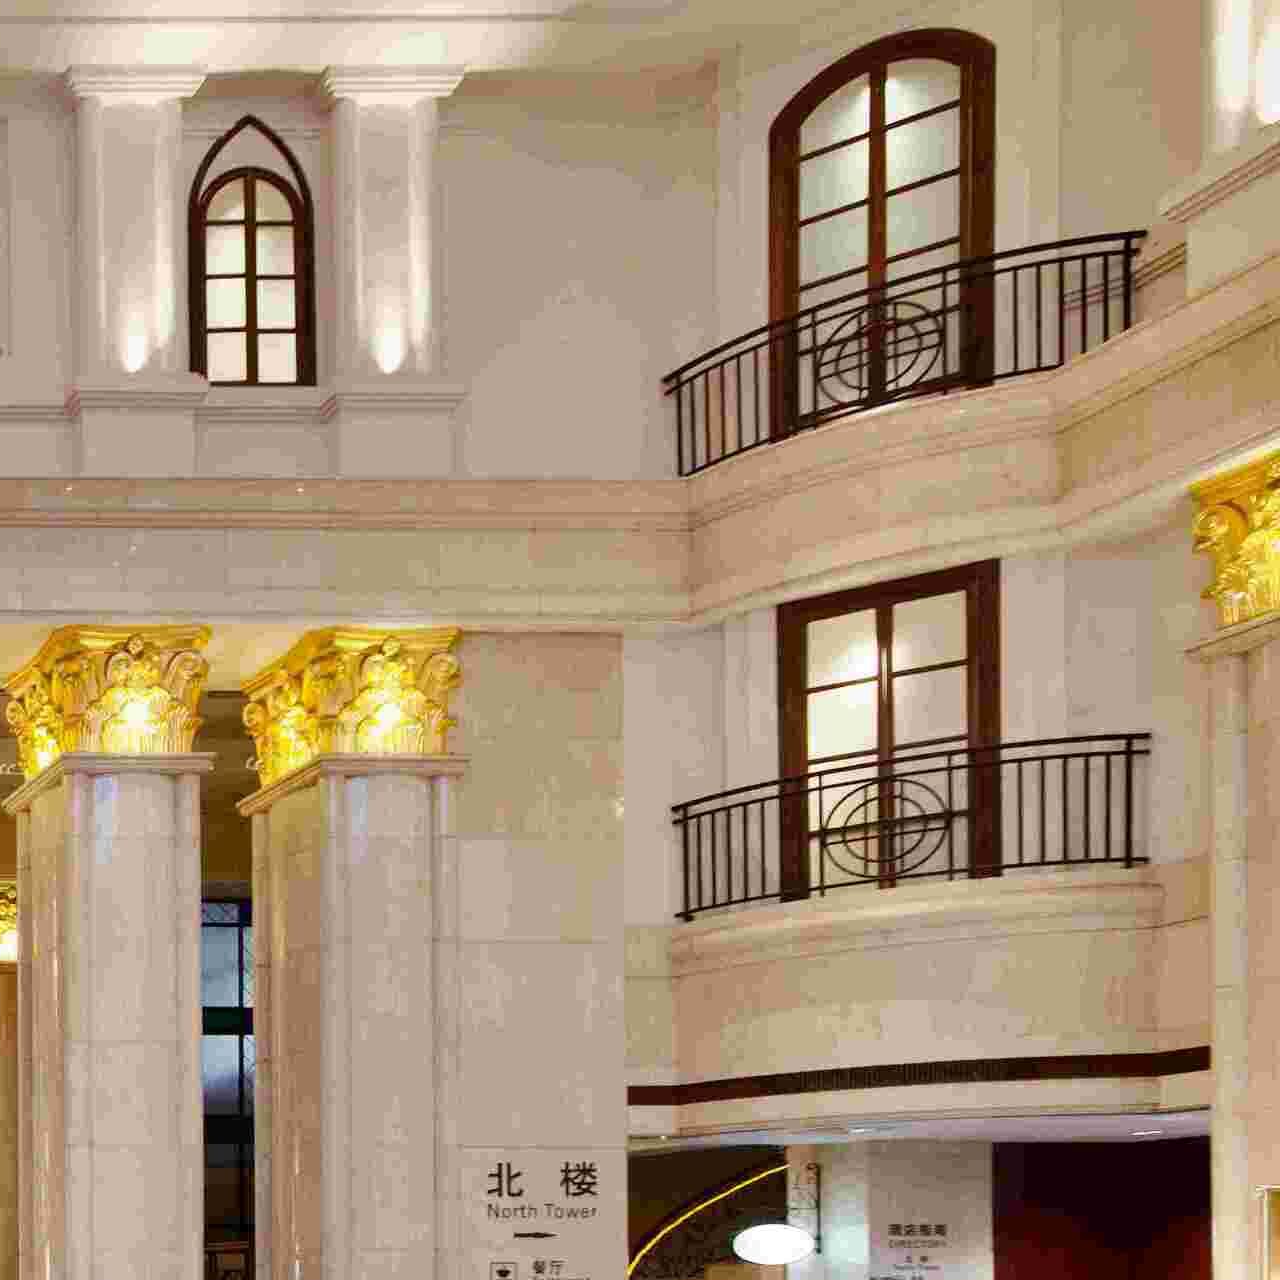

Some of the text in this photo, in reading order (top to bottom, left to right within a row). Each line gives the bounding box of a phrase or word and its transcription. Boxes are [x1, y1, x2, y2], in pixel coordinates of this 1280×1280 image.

[487, 1161, 599, 1198] 北楼
[487, 1204, 597, 1219] North Tower
